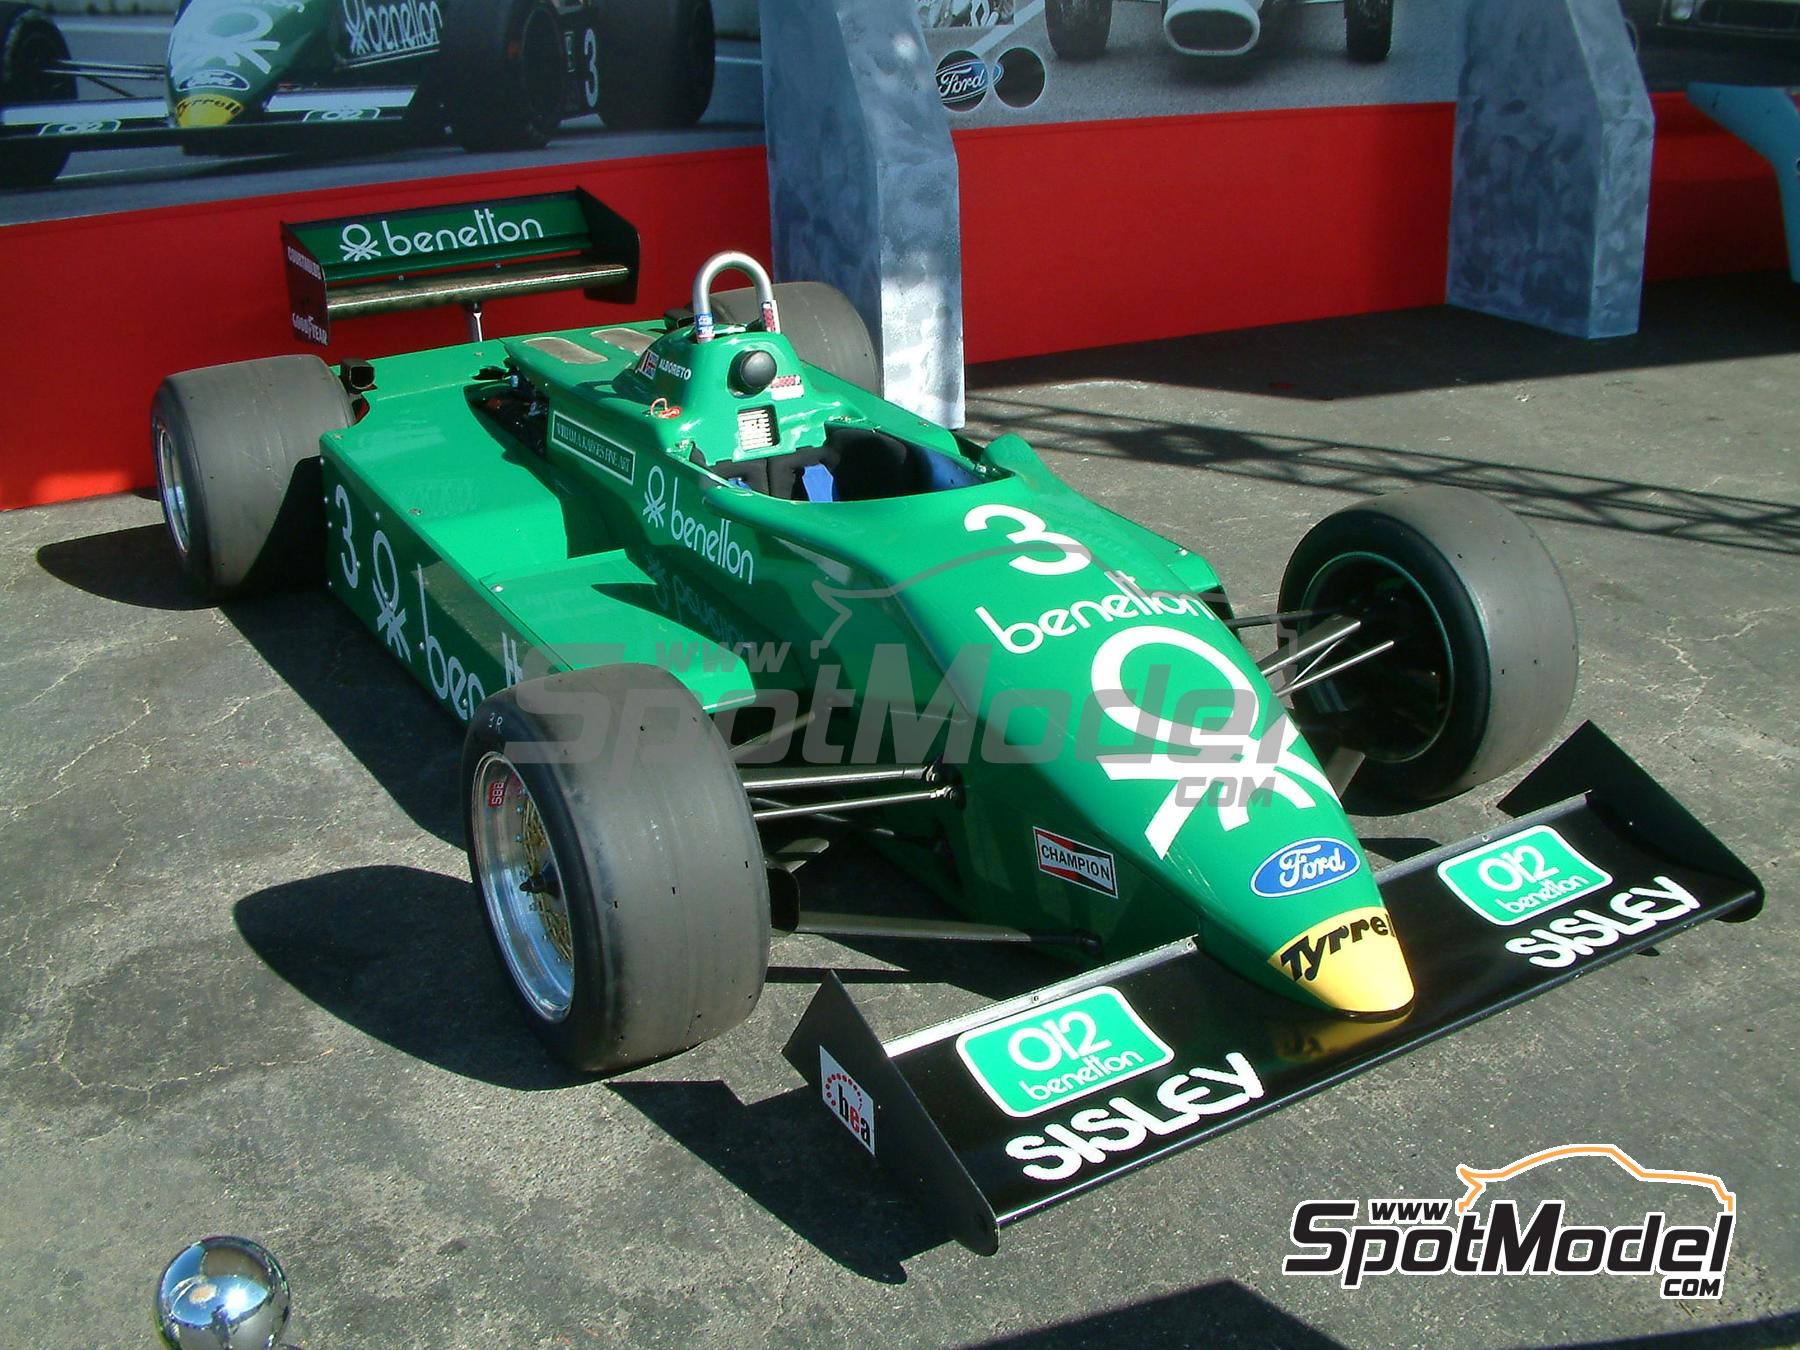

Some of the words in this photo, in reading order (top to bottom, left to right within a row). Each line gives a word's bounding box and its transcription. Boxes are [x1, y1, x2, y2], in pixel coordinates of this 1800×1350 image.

[584, 28, 600, 108] 3
[938, 66, 985, 97] Ford
[381, 208, 544, 257] benetton
[658, 357, 692, 381] ALBORETO
[335, 484, 359, 589] 3
[670, 476, 754, 585] benetton
[963, 503, 1092, 576] 3
[974, 569, 1216, 655] benetton
[1040, 843, 1112, 883] CHAMPION
[1279, 844, 1348, 889] Ford
[1477, 845, 1560, 893] 012
[1494, 873, 1590, 914] benetton
[1504, 875, 1701, 969] SISLEY
[1007, 1010, 1113, 1072] 012
[1017, 1048, 1144, 1102] benetton
[1004, 1051, 1265, 1181] SISLEY
